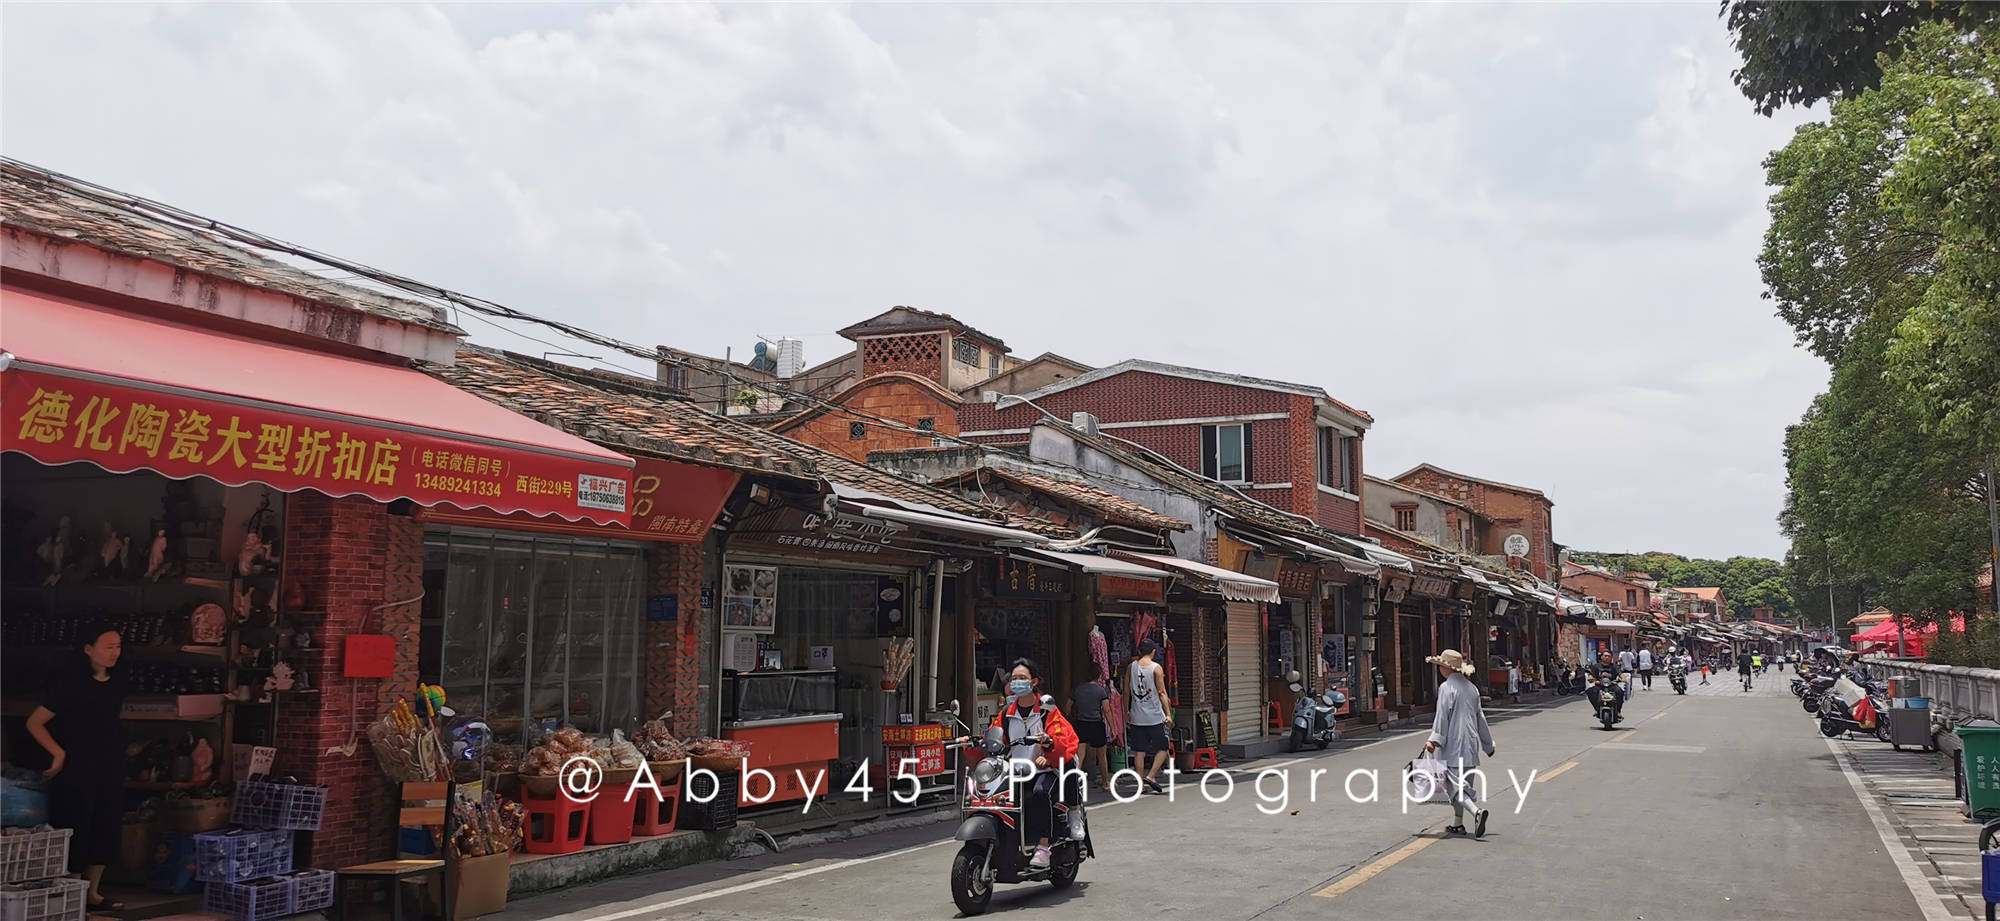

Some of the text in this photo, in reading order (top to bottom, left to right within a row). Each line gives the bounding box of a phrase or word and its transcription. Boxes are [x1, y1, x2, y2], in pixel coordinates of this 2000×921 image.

[18, 386, 402, 486] 德化陶瓷大型折扣店
[414, 472, 502, 498] 13489241334
[515, 474, 574, 499] 西街229号
[589, 477, 625, 495] 福兴广告
[920, 759, 941, 772] 土笋冻
